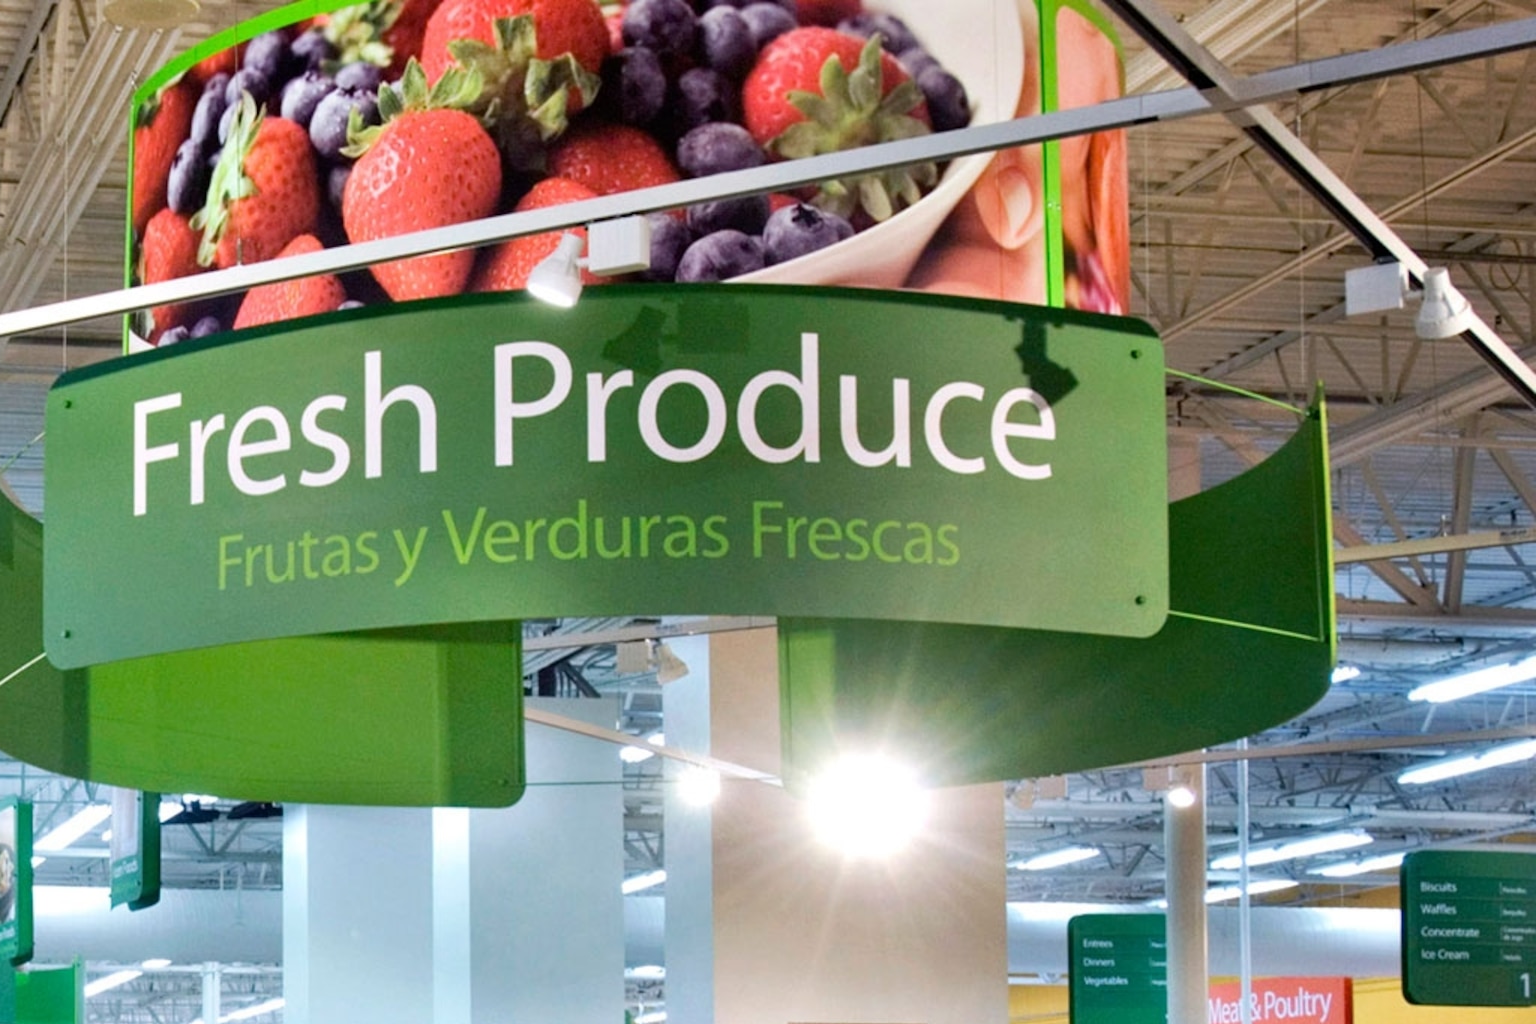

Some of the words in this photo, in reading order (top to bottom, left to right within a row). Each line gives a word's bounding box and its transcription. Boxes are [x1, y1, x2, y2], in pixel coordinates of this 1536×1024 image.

[131, 351, 440, 516] Fresh
[493, 333, 1056, 481] Produce
[217, 528, 381, 592] Frutas
[392, 526, 422, 586] y
[442, 501, 730, 566] Verduras
[750, 502, 961, 568] Frescas
[1420, 881, 1457, 892] Biscuits
[1420, 903, 1457, 915] Waffles
[1421, 926, 1480, 938] Concentrate
[1083, 938, 1114, 948] Entrees
[1421, 949, 1436, 960] Ice
[1438, 949, 1470, 960] Cream
[1083, 958, 1115, 967] Dinners
[1084, 976, 1129, 987] Vegetables
[1520, 973, 1530, 998] 1
[1265, 986, 1333, 1023] Poultry
